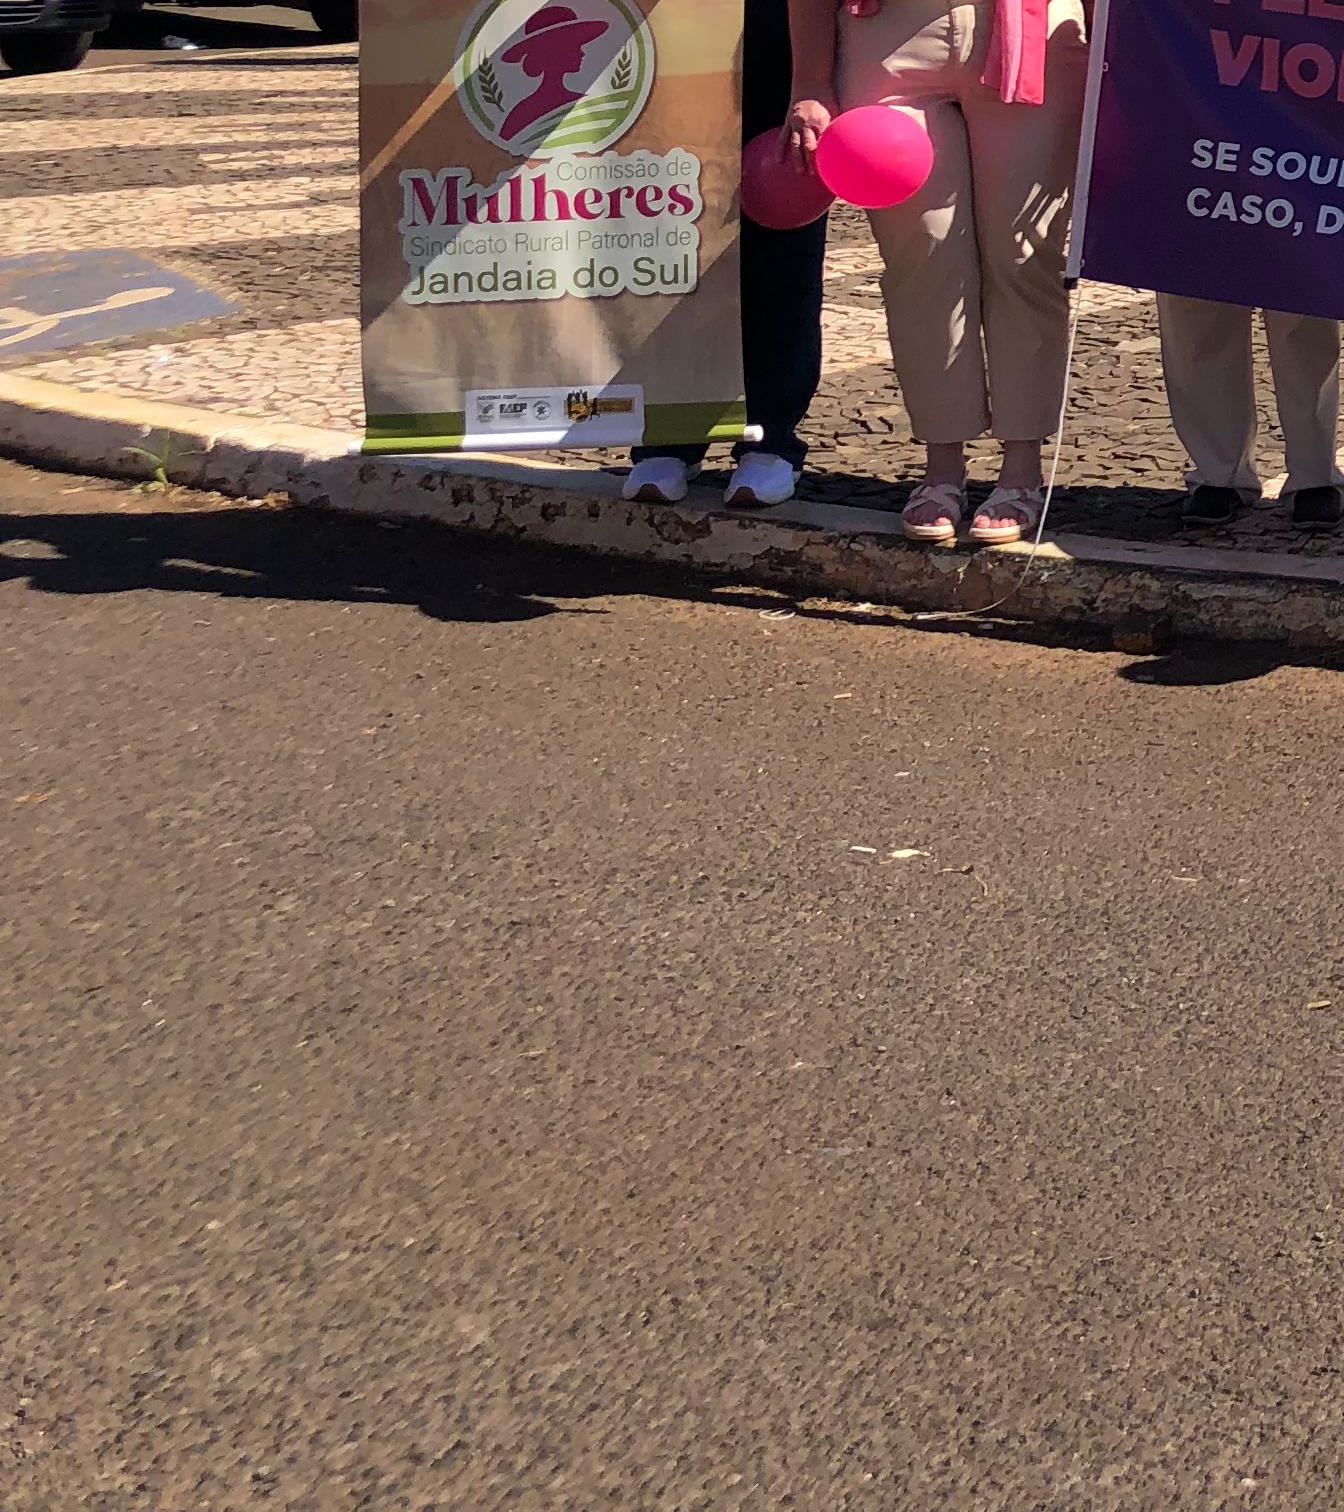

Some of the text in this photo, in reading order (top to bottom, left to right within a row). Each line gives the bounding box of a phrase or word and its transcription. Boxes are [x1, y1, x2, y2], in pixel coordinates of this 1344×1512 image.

[556, 157, 692, 181] Comissão de
[1190, 137, 1239, 174] SE
[407, 172, 695, 227] Mulheres
[1186, 187, 1305, 237] CASO,
[410, 226, 692, 257] Sindicato Rural Patronal de
[411, 253, 690, 296] Jandaia do Sul
